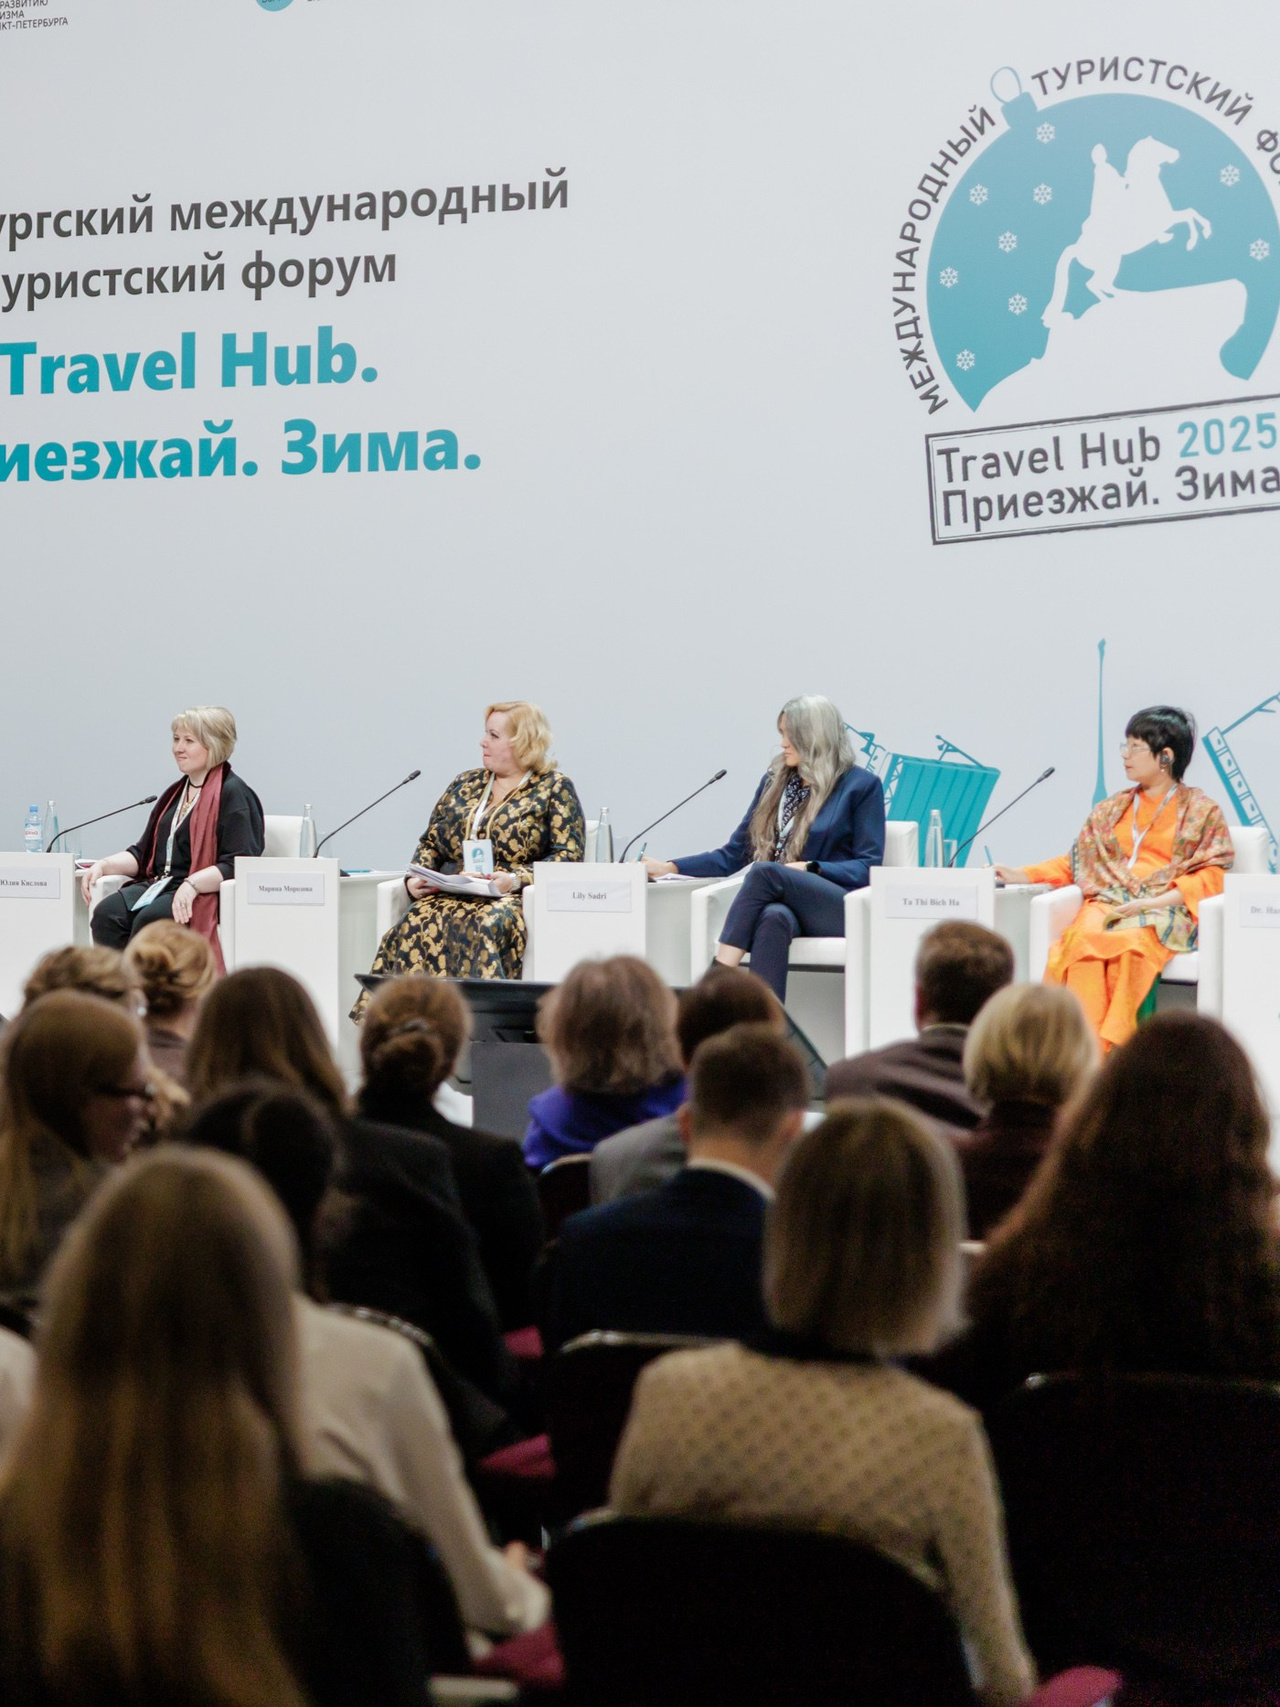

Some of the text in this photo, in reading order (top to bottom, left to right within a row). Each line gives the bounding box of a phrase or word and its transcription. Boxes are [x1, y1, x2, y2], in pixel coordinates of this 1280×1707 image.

[0, 0, 48, 9] РАЗВИТИЮ
[170, 168, 570, 237] международный
[892, 104, 996, 414] МЕЖДУНАРОДНЫЙ
[1031, 56, 1253, 126] ТУРИСТСКИЙ
[241, 250, 397, 300] форум
[222, 325, 378, 388] Hub.
[280, 418, 483, 475] Зима.
[937, 436, 1064, 483] Travel
[1080, 426, 1161, 469] Hub
[942, 466, 1160, 532] Приезжай.
[572, 891, 586, 901] Lily
[903, 898, 913, 906] Ta
[915, 898, 928, 906] Thi
[930, 898, 947, 906] Bich
[1250, 906, 1263, 914] Dr.
